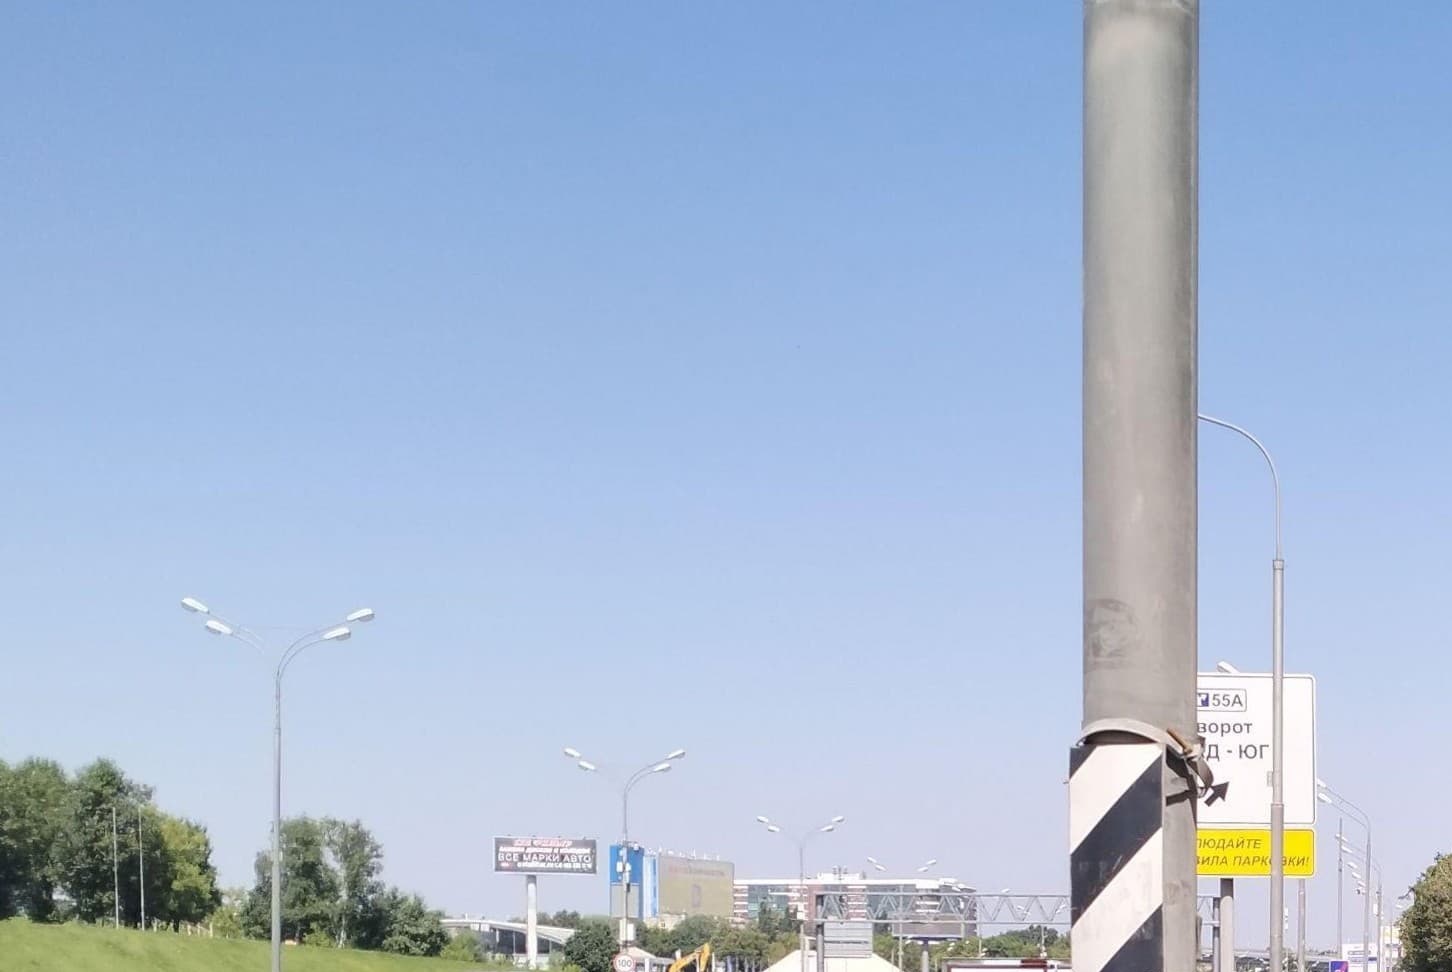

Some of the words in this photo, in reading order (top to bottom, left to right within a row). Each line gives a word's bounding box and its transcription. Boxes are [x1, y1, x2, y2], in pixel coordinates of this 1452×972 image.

[1196, 722, 1253, 737] ворот
[1238, 744, 1270, 759] ЮГ
[1196, 837, 1262, 851] ЛЮДАЙТЕ
[1196, 856, 1228, 866] ВИЛА
[1233, 856, 1310, 866] ПАРКВКИ!
